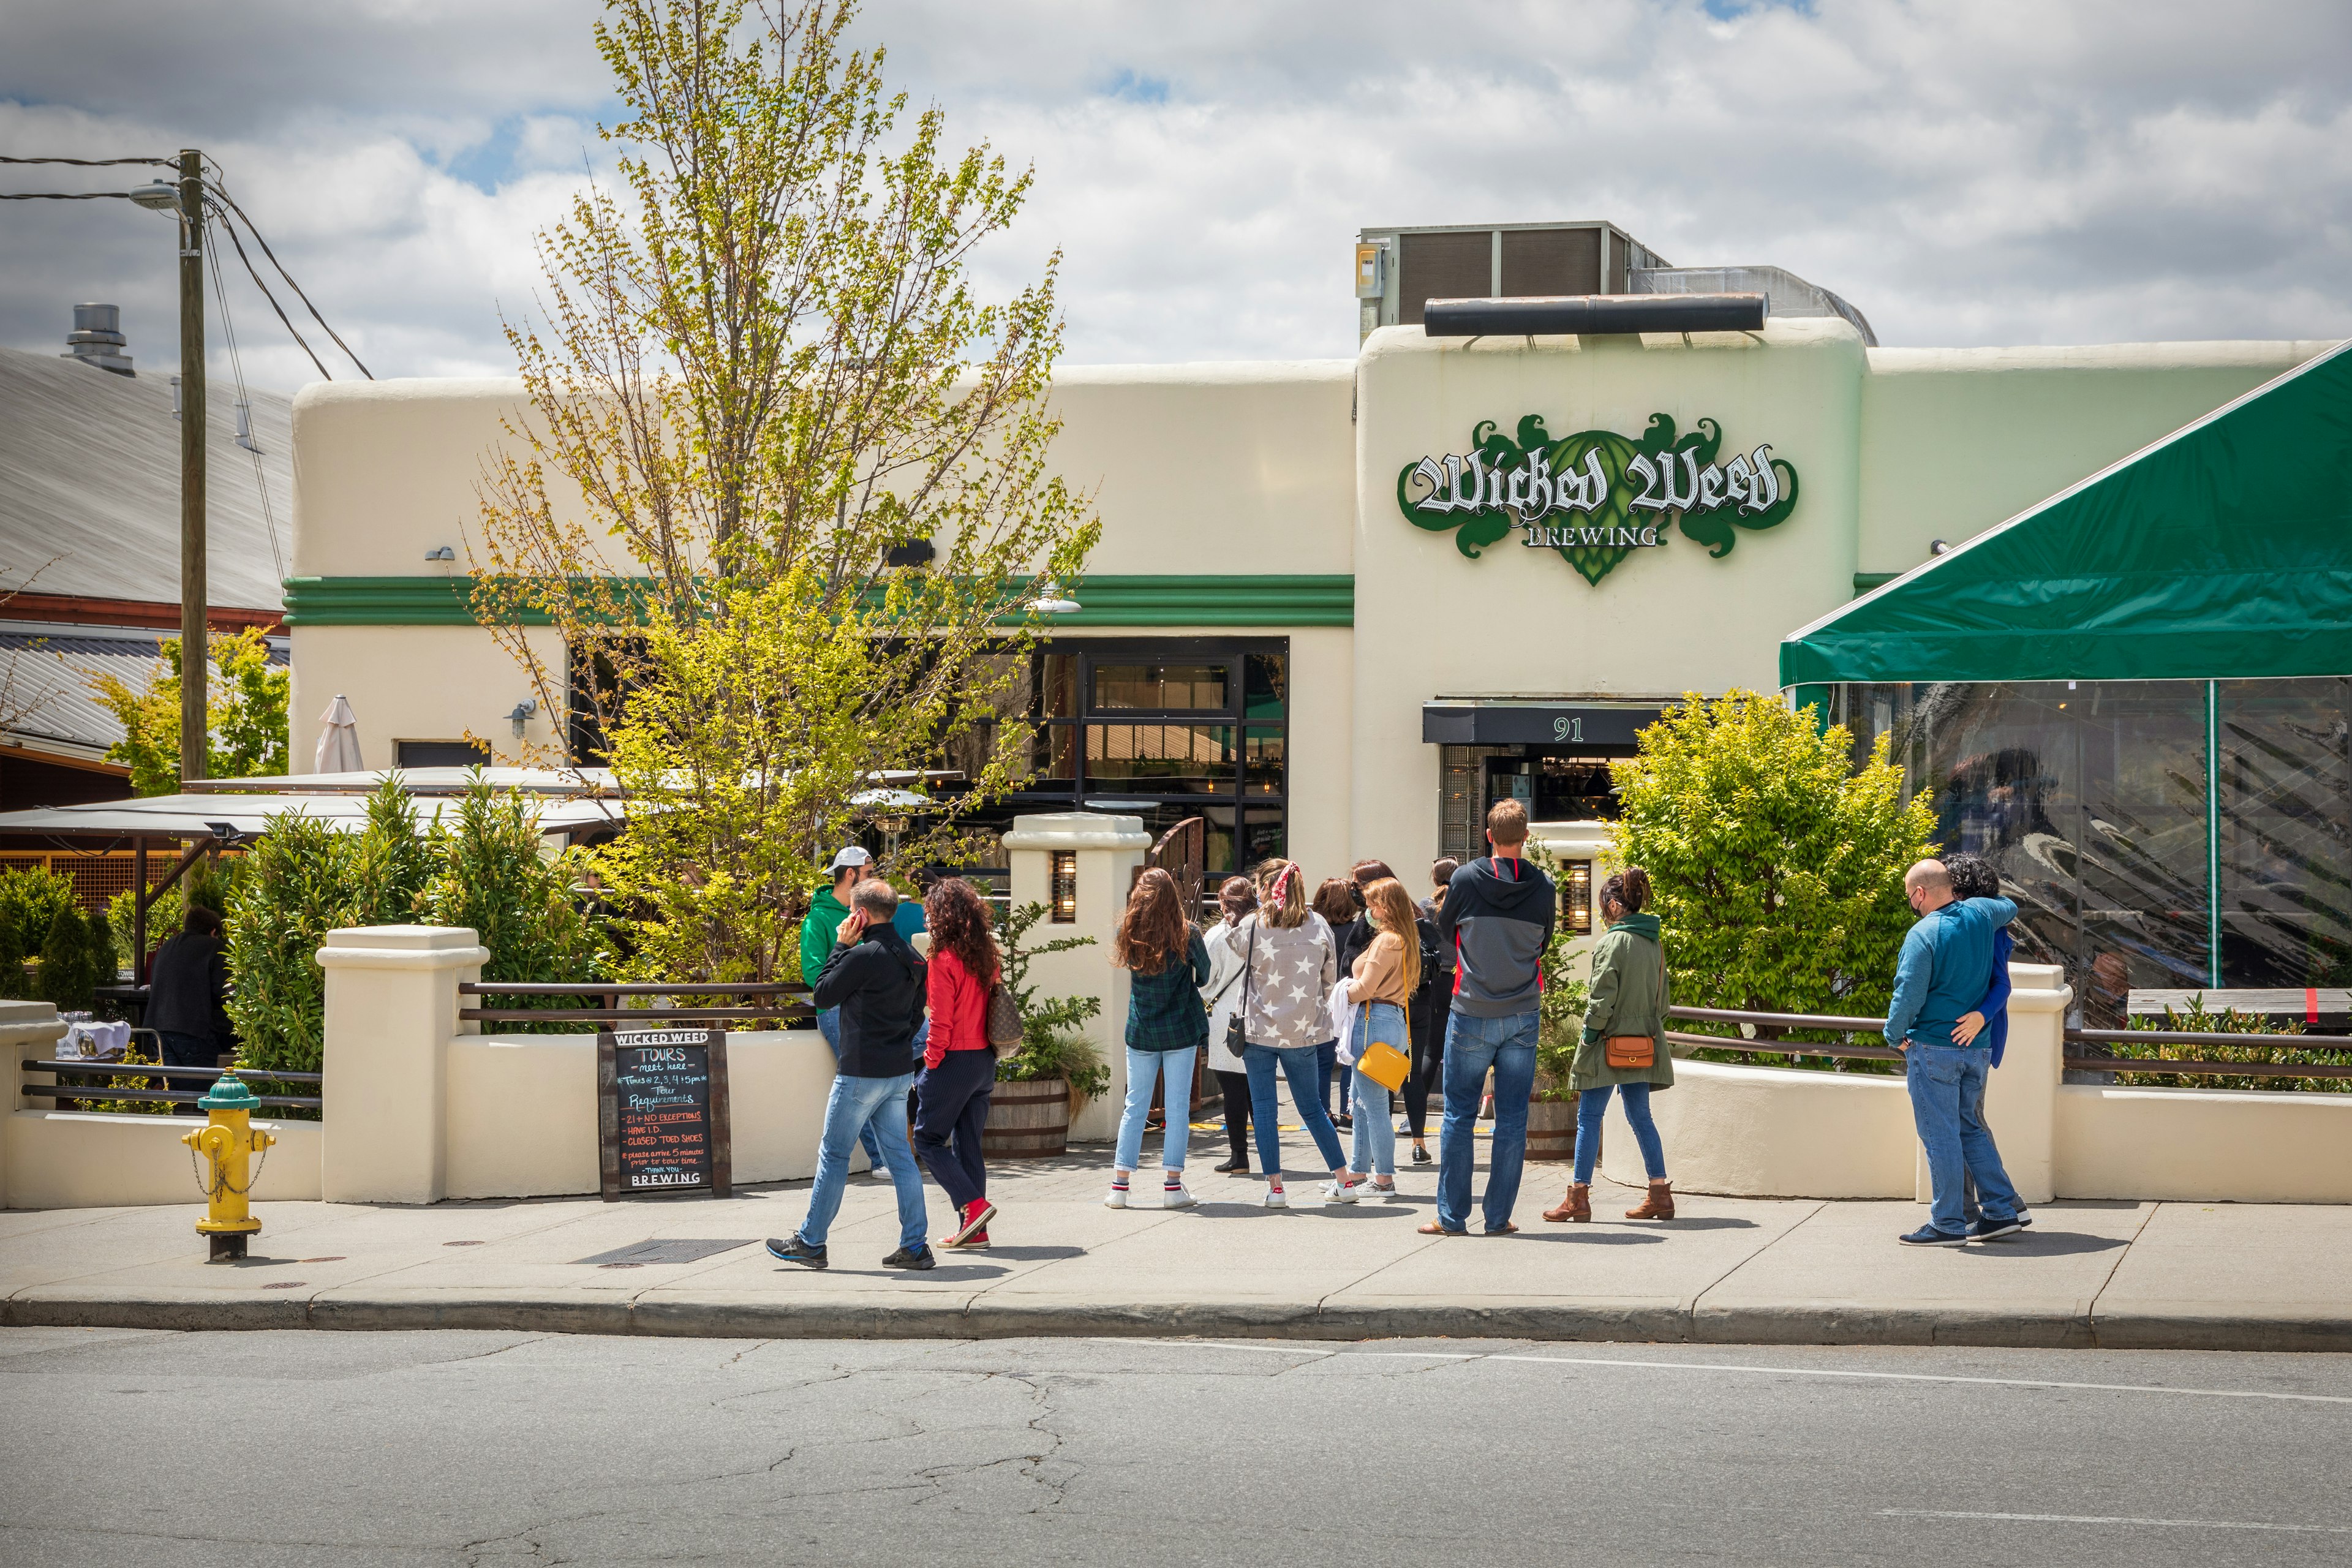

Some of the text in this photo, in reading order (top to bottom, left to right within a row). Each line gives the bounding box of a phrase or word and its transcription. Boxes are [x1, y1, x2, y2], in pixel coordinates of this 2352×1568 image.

[1412, 444, 1779, 529] Wicked Weed
[1528, 526, 1657, 545] BREWING
[1554, 717, 1583, 741] 91
[615, 1032, 709, 1045] WICKED WEED
[636, 1048, 686, 1062] TOURS
[651, 1086, 676, 1095] Tour
[629, 1095, 693, 1112] Requirements
[660, 1111, 701, 1121] EXCEPTIONS
[628, 1137, 657, 1145] CLOSED
[682, 1134, 703, 1143] SHOES
[628, 1152, 650, 1160] please
[631, 1159, 649, 1168] prior
[632, 1172, 700, 1186] BREWING
